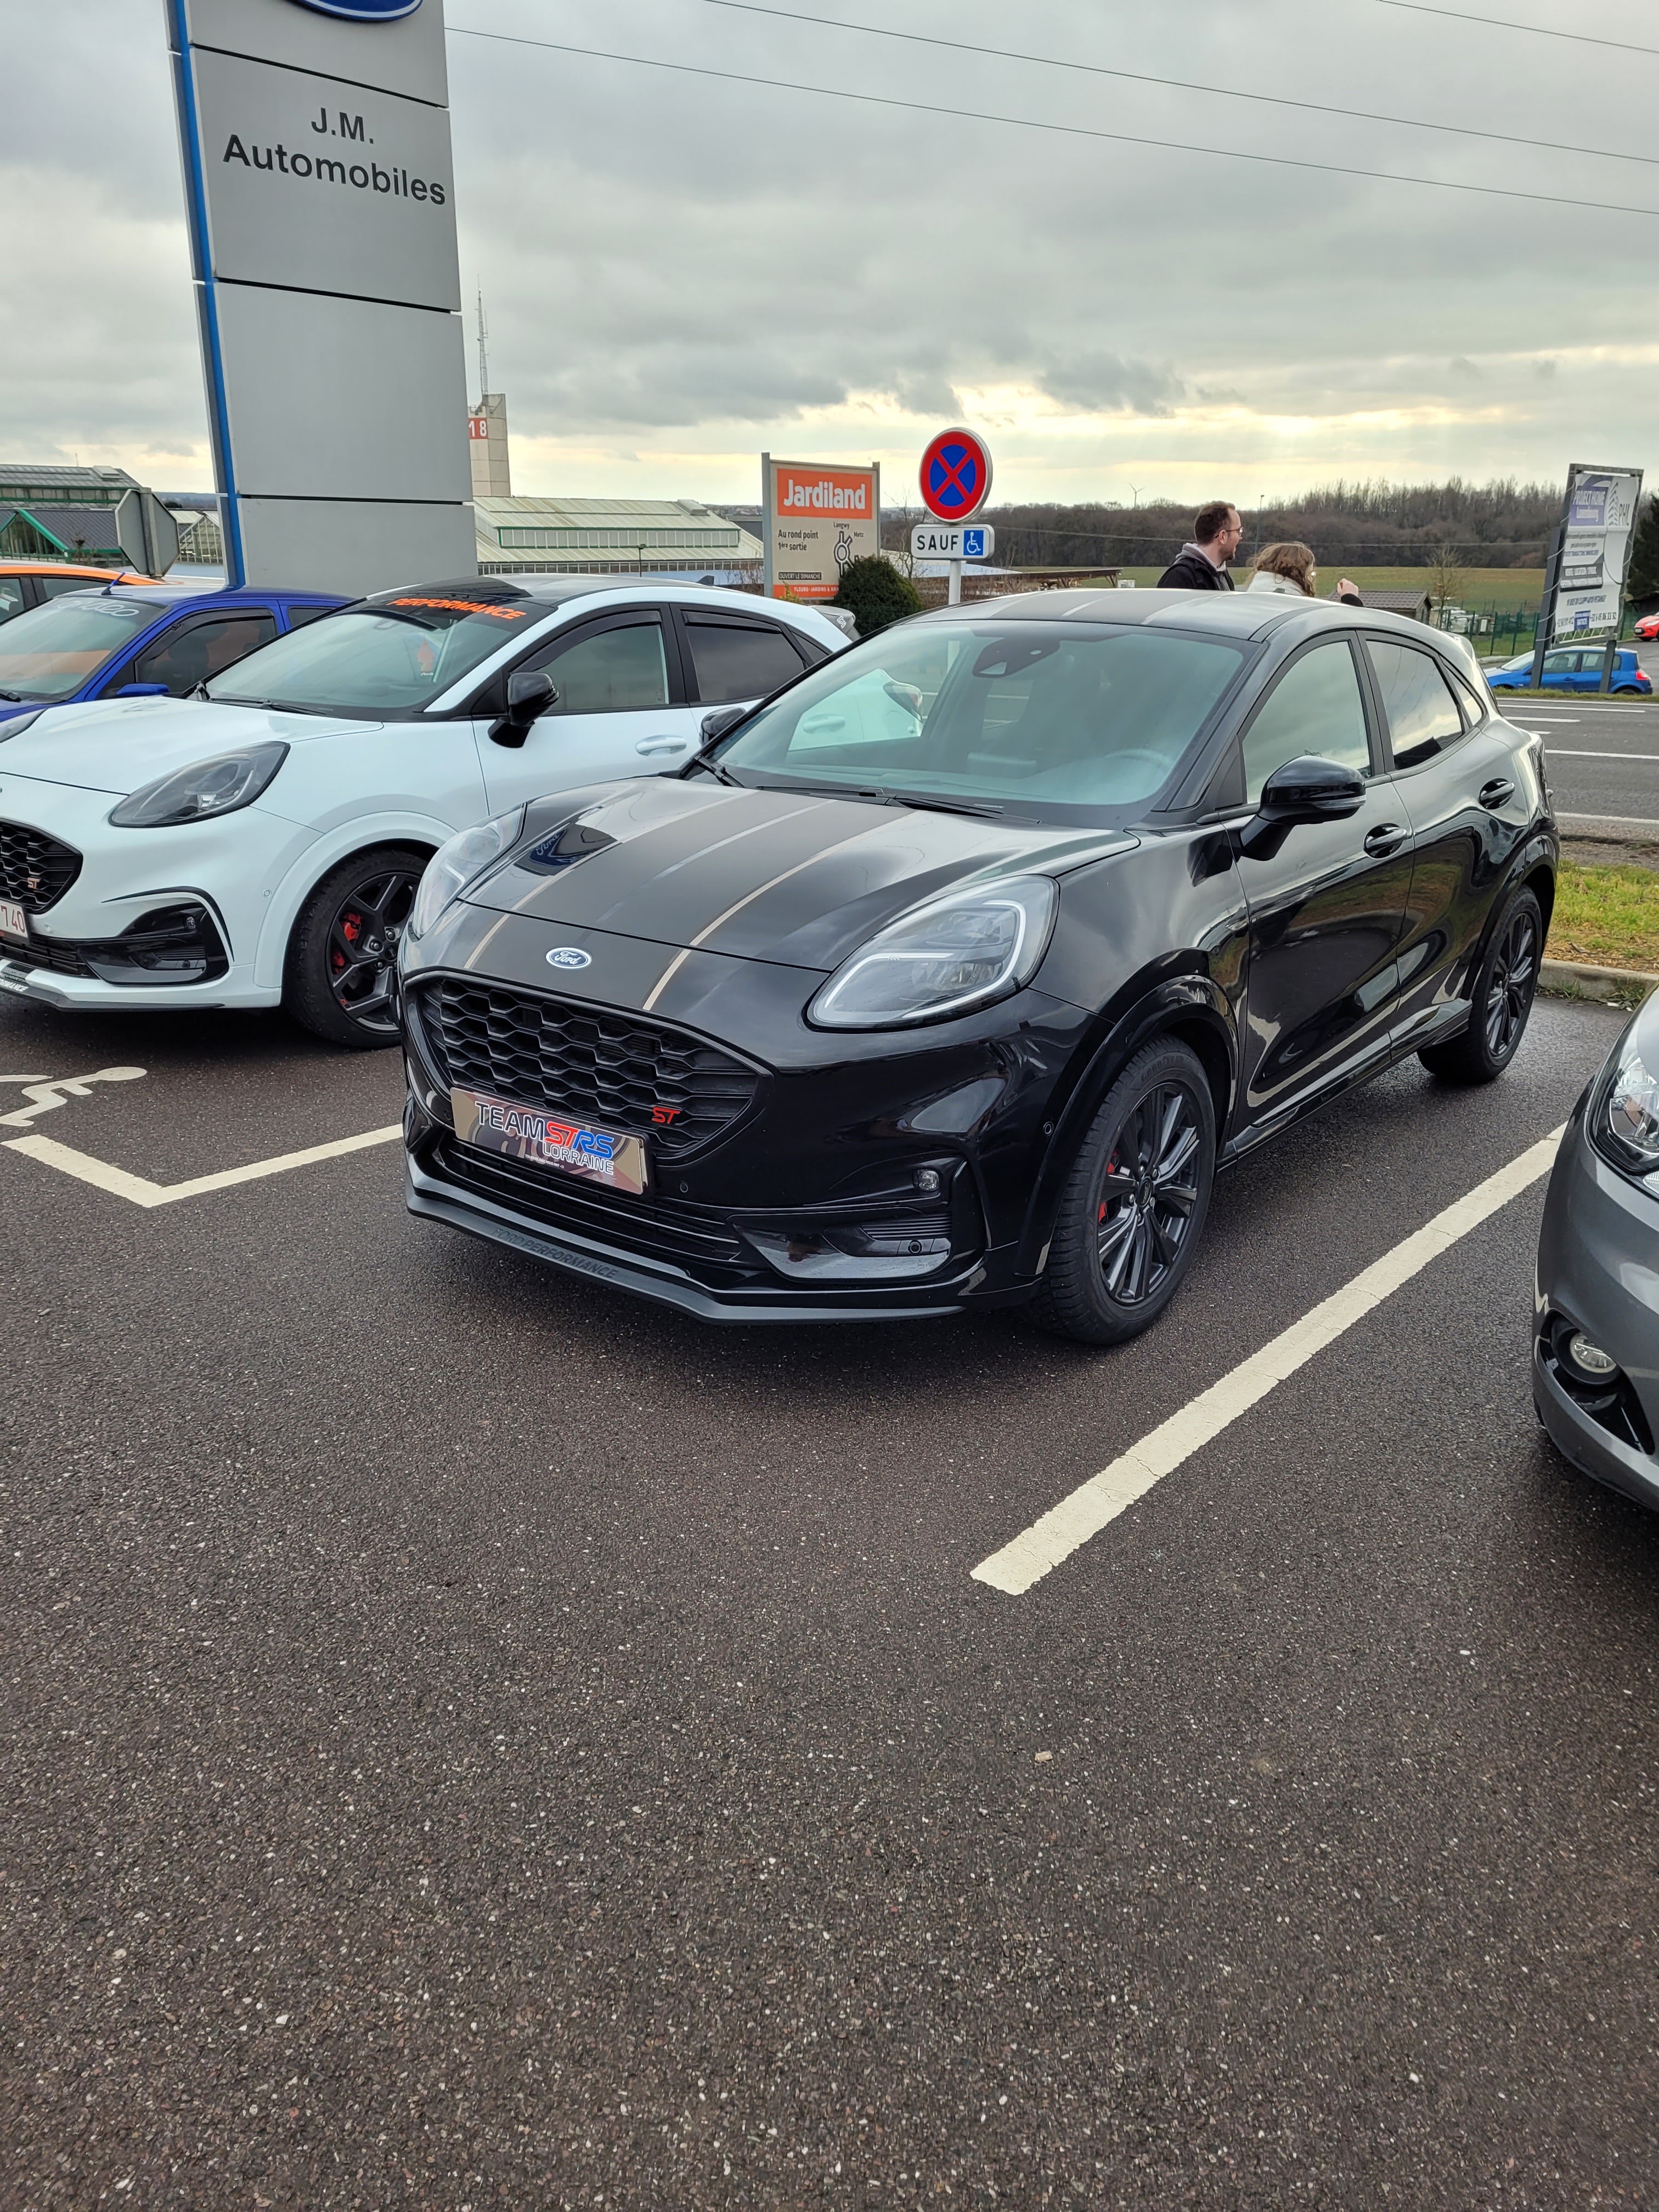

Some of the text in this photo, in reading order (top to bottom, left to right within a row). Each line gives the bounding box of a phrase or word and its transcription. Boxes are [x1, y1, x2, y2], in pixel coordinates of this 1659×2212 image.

[311, 107, 374, 144] J.M.
[223, 134, 445, 205] Automobiles
[783, 479, 866, 510] Jardiland
[778, 529, 819, 541] Au rond point
[778, 541, 807, 550] 1ère sortie
[917, 534, 958, 551] SAUF
[386, 597, 527, 620] PERFORMANCE
[27, 878, 40, 889] ST
[554, 951, 582, 964] Ford
[651, 1106, 681, 1125] ST
[543, 1141, 614, 1175] LORRAINE
[491, 1228, 619, 1278] FORD PERFORMANCE
